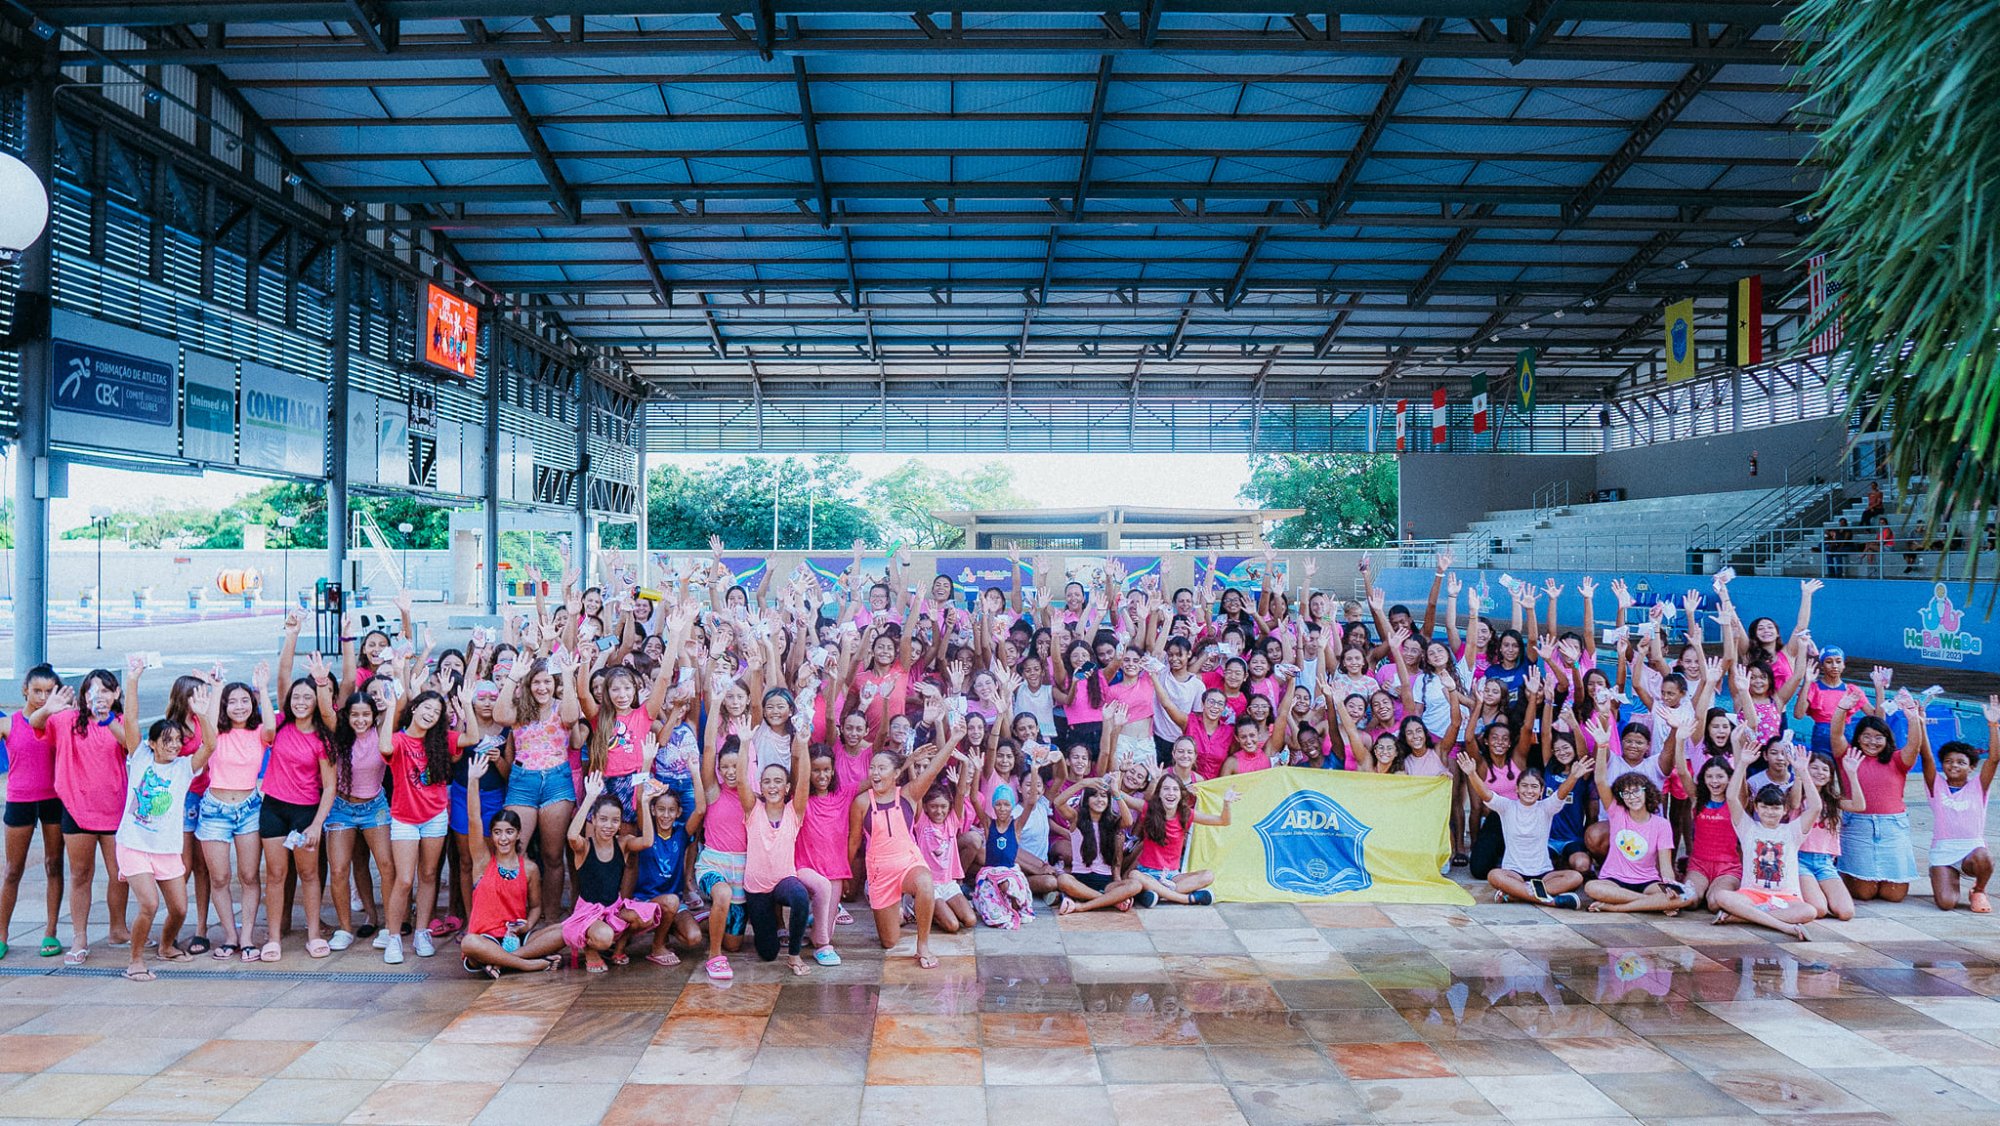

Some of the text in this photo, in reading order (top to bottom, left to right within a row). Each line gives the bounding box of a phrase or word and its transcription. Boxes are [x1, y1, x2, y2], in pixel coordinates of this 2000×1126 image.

[95, 361, 167, 385] FORMAÇÃO DE ATLETAS
[95, 383, 119, 407] CBC
[190, 394, 219, 410] Unimed
[1905, 629, 1981, 653] HaBaWaBa
[1922, 648, 1941, 658] Brasil
[1281, 810, 1340, 830] ABDA
